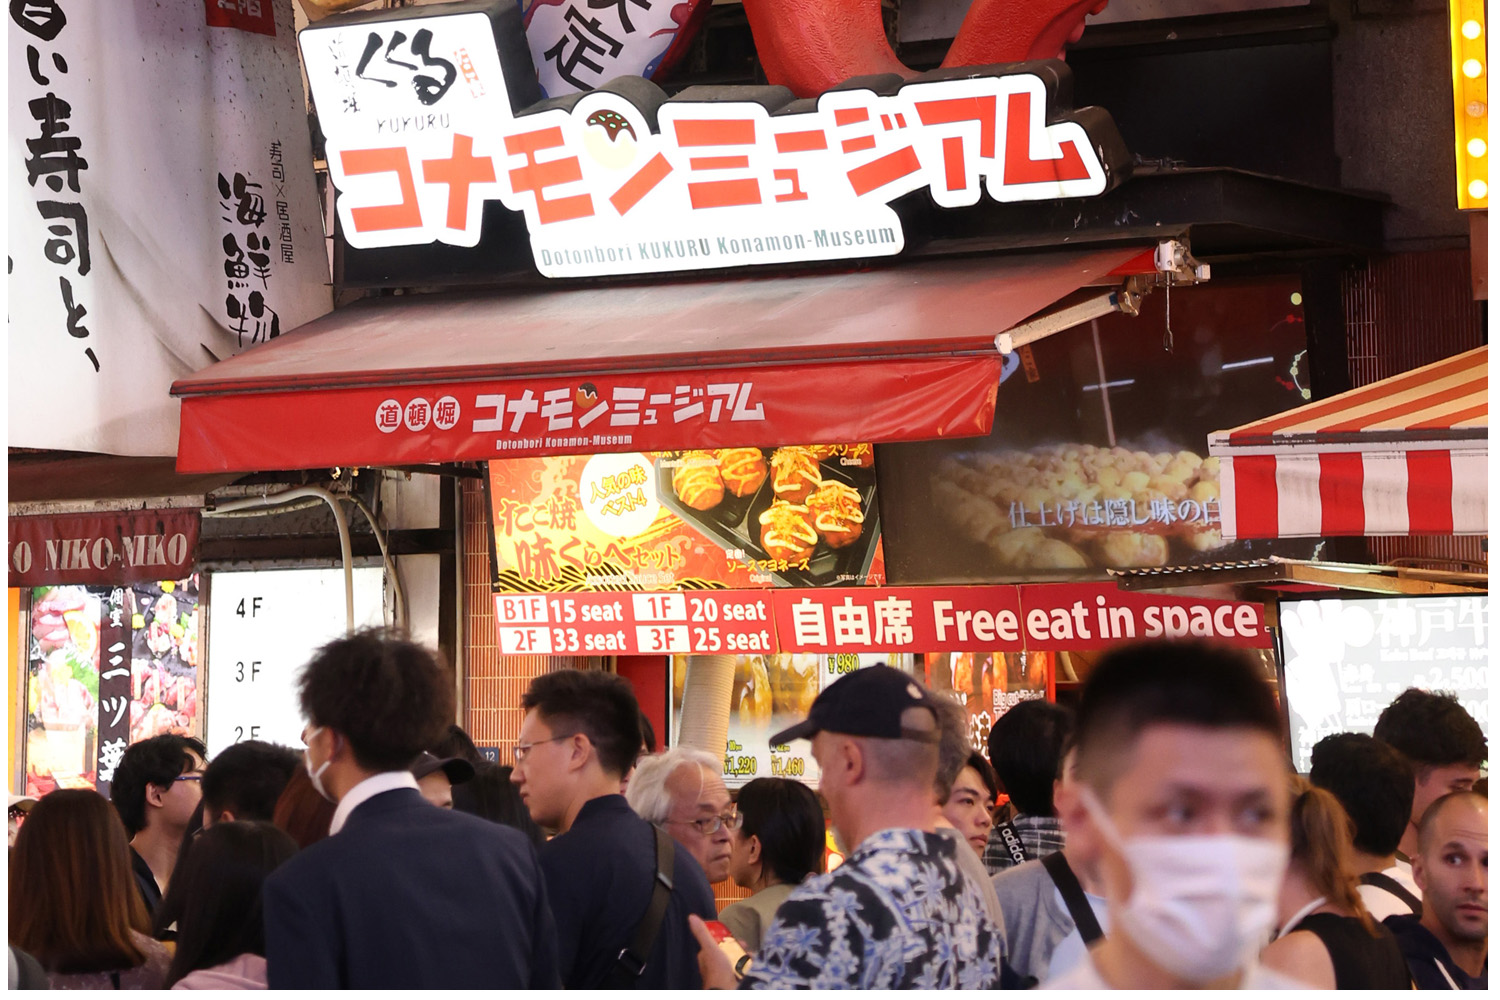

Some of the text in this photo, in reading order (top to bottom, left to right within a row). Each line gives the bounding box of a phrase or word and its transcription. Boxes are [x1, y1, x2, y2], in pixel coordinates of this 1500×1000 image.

[340, 91, 1091, 233] コナモンミュージアム
[269, 139, 294, 264] 寿司×居酒屋
[541, 226, 896, 267] Dotonbori KUKURU Konamon-Museum
[377, 396, 459, 433] 道頓堀
[472, 382, 765, 434] コナモンミュージアム
[496, 434, 632, 450] Dotonbori Konamon-Museum
[590, 464, 647, 503] 人気の味
[500, 495, 577, 537] たこ焼
[514, 532, 680, 584] 味くらべセット
[726, 558, 810, 573] ソースマヨネーズ
[504, 599, 541, 621] B1F
[550, 599, 623, 624] 15 seat
[648, 596, 672, 618] 1F
[690, 598, 766, 622] 20 seat
[791, 596, 914, 647] 自由席
[933, 596, 1259, 642] Free eat in space
[514, 630, 537, 651] 2F
[554, 628, 626, 652] 33 seat
[651, 628, 675, 650] 3F
[694, 628, 770, 651] 25 seat
